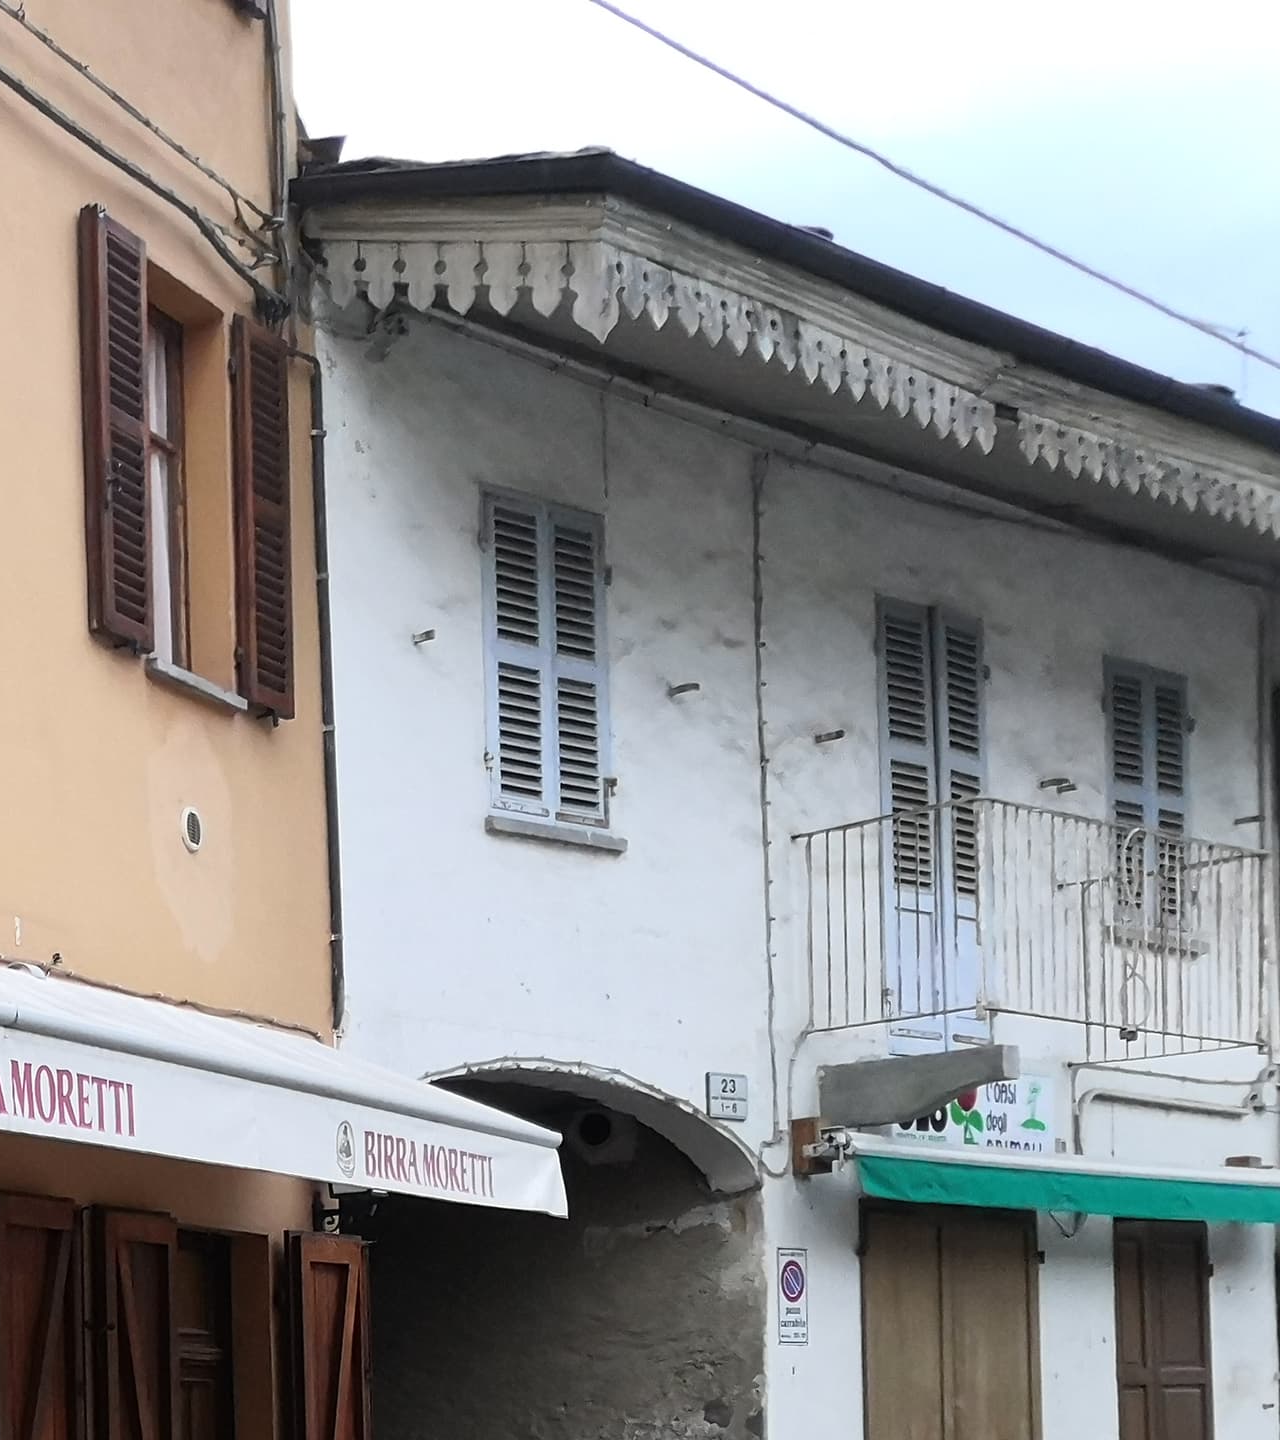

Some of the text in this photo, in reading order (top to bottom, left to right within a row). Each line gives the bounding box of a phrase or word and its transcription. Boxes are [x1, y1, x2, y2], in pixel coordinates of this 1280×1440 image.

[11, 1059, 136, 1137] MORETTI
[721, 1078, 737, 1094] 23
[364, 1130, 495, 1198] BIRRA MORETTI
